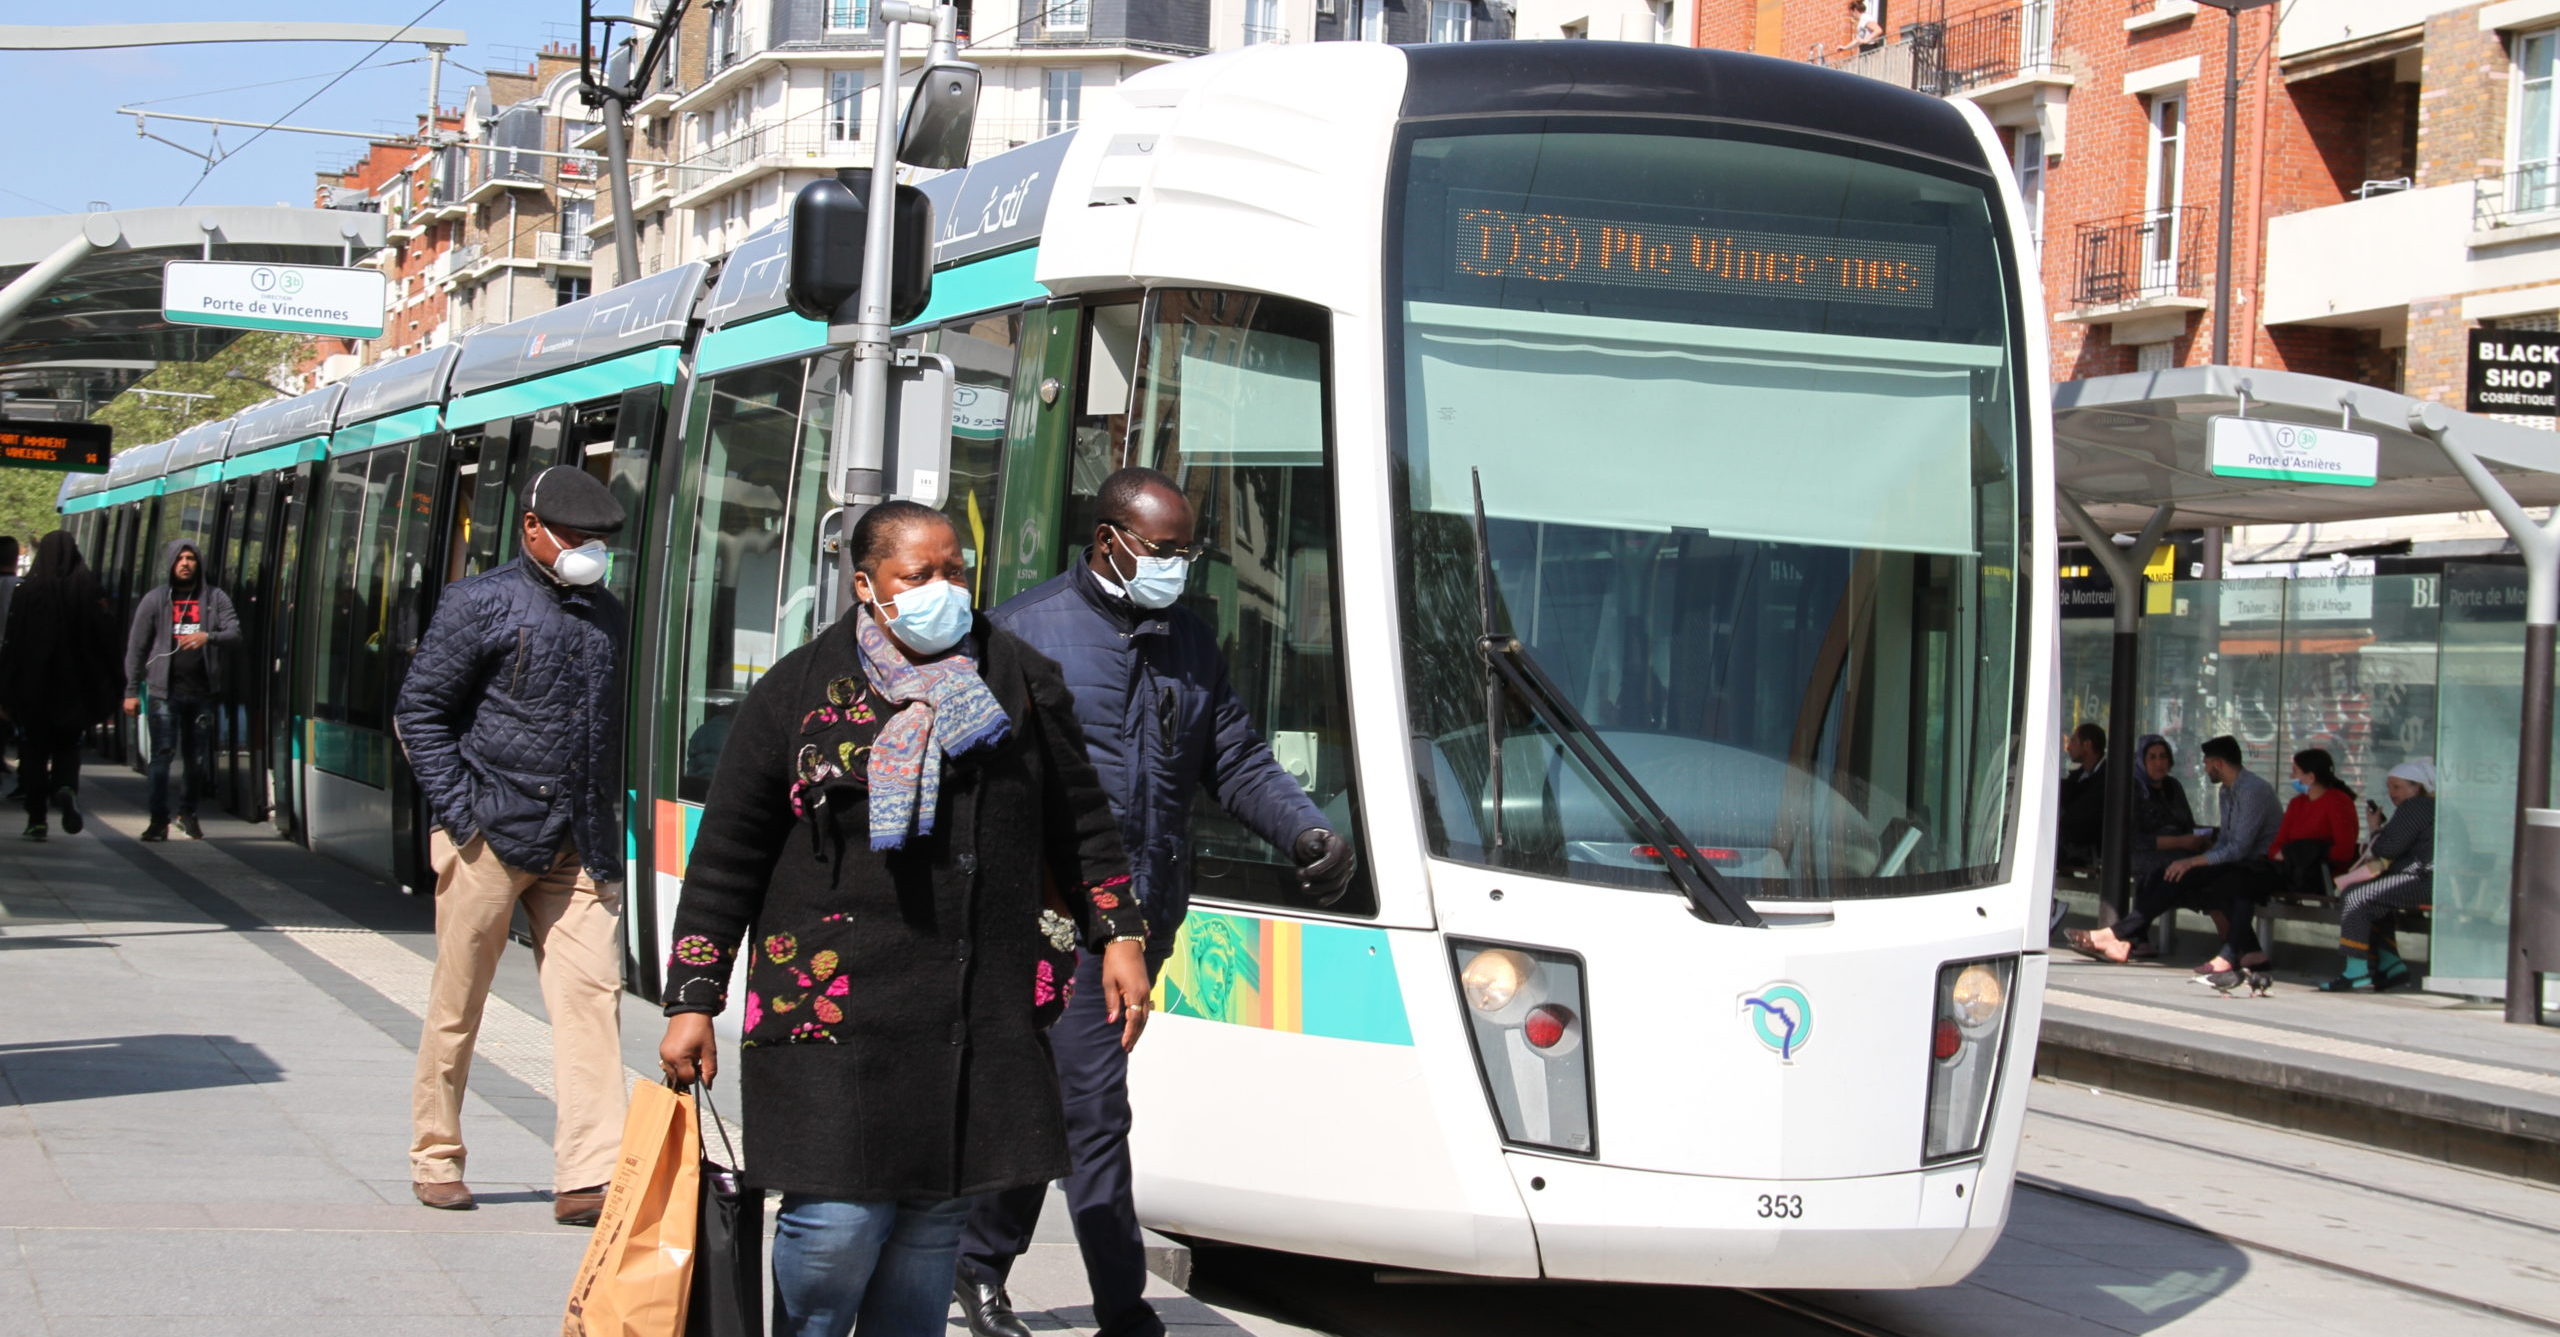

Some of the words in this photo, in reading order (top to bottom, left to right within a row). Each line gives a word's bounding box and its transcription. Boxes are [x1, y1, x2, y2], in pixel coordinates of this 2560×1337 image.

[203, 296, 244, 313] Porte
[249, 299, 267, 314] de
[272, 302, 349, 321] Vincennes
[2479, 342, 2560, 364] BLACK
[2485, 368, 2552, 388] SHOP
[2479, 391, 2556, 406] COSMÉTIQUE
[2248, 453, 2279, 466] Porte
[2282, 454, 2341, 471] d'Asnières
[2450, 588, 2482, 606] Porte
[2486, 587, 2502, 605] de
[1756, 1194, 1804, 1219] 353
